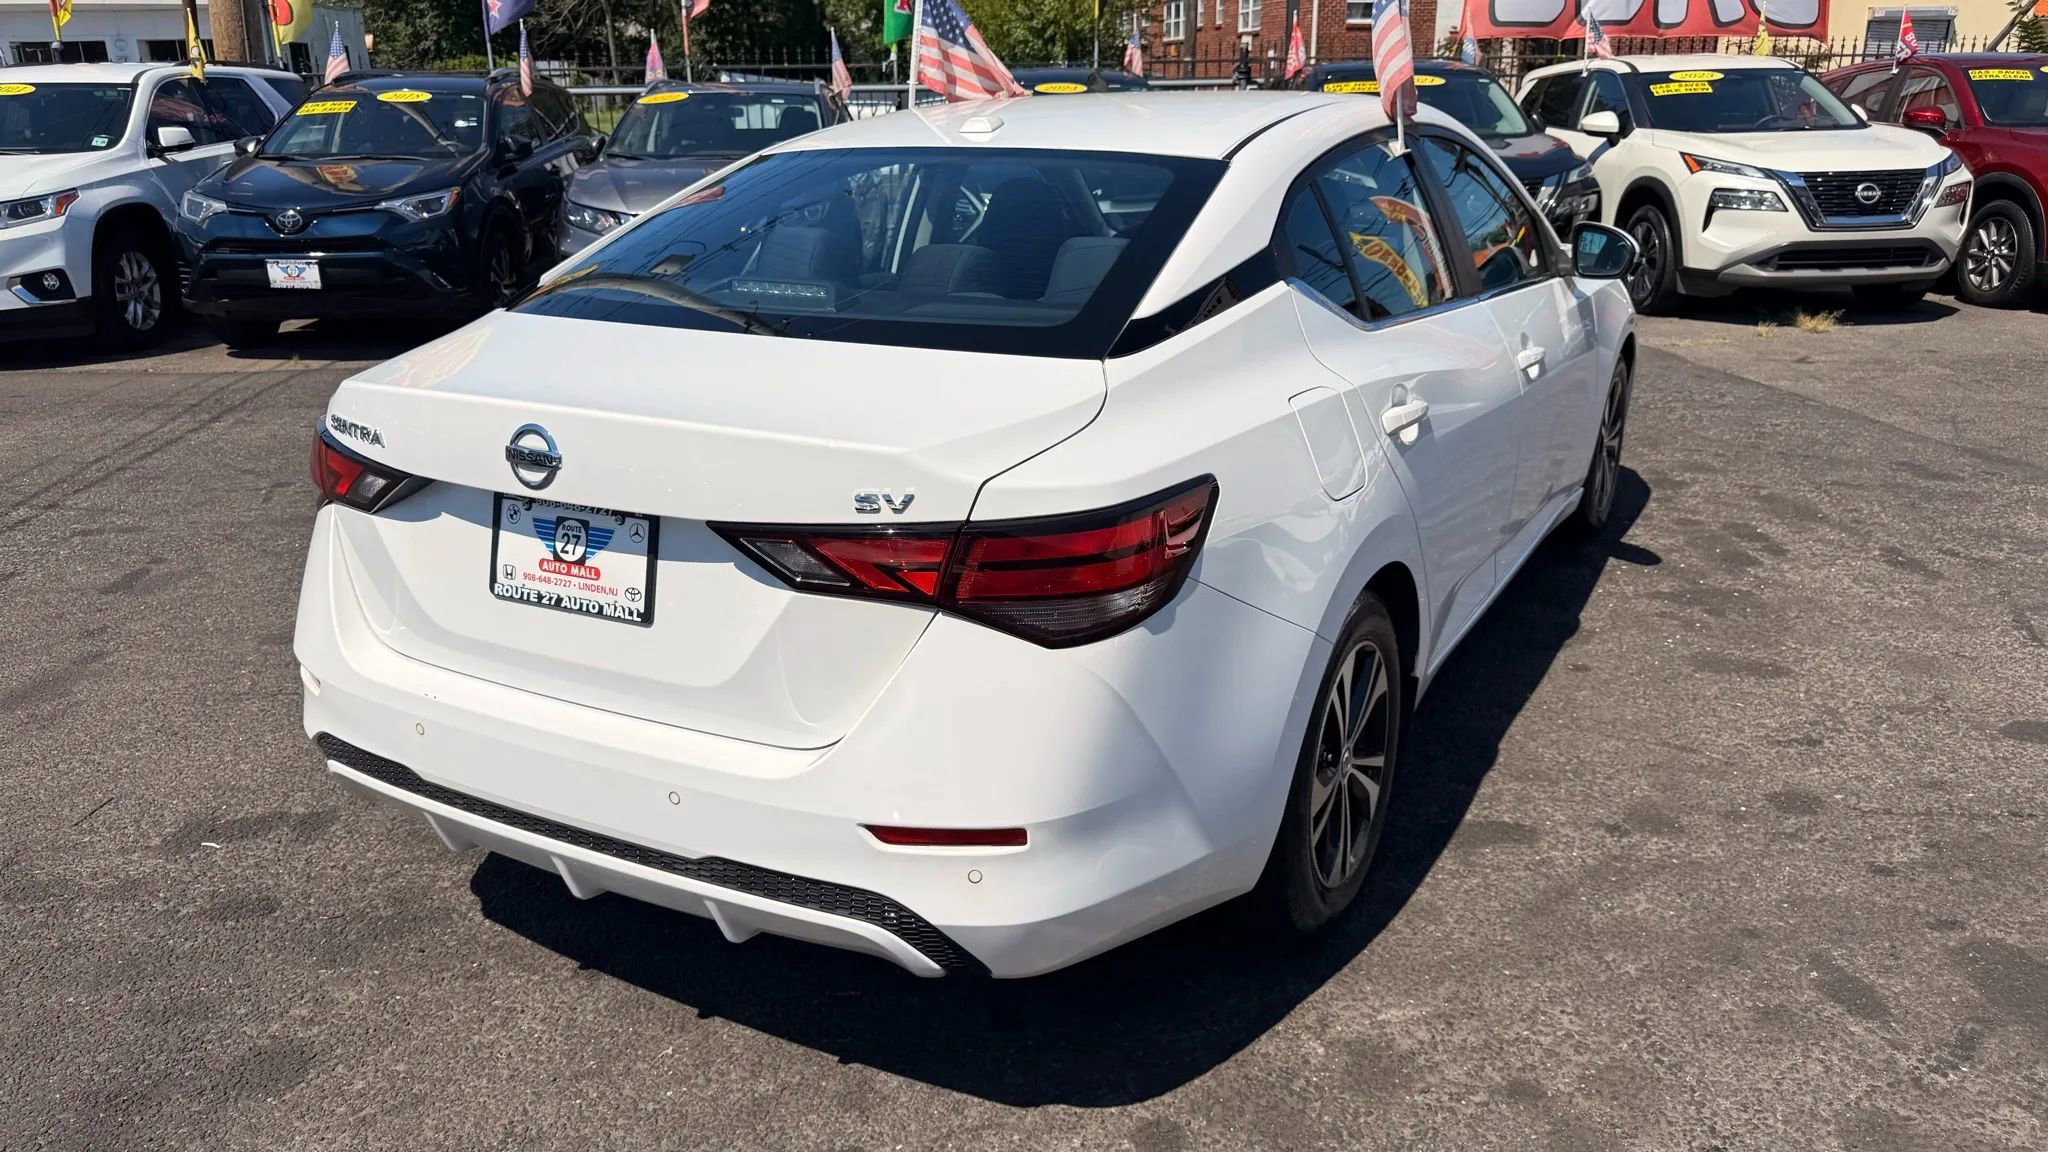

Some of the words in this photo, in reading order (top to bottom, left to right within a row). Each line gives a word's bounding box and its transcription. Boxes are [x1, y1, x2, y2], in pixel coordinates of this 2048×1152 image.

[331, 414, 386, 448] SENTRA
[508, 447, 555, 467] NISSAN
[854, 493, 915, 514] SV
[561, 523, 583, 534] ROUTE
[560, 534, 582, 555] 27
[542, 560, 568, 574] AUTO
[570, 565, 598, 579] MALL
[522, 571, 572, 589] 908-648-2727
[494, 583, 539, 602] ROUTE
[541, 593, 558, 607] 27
[560, 596, 599, 614] AUTO
[602, 603, 642, 622] MALL
